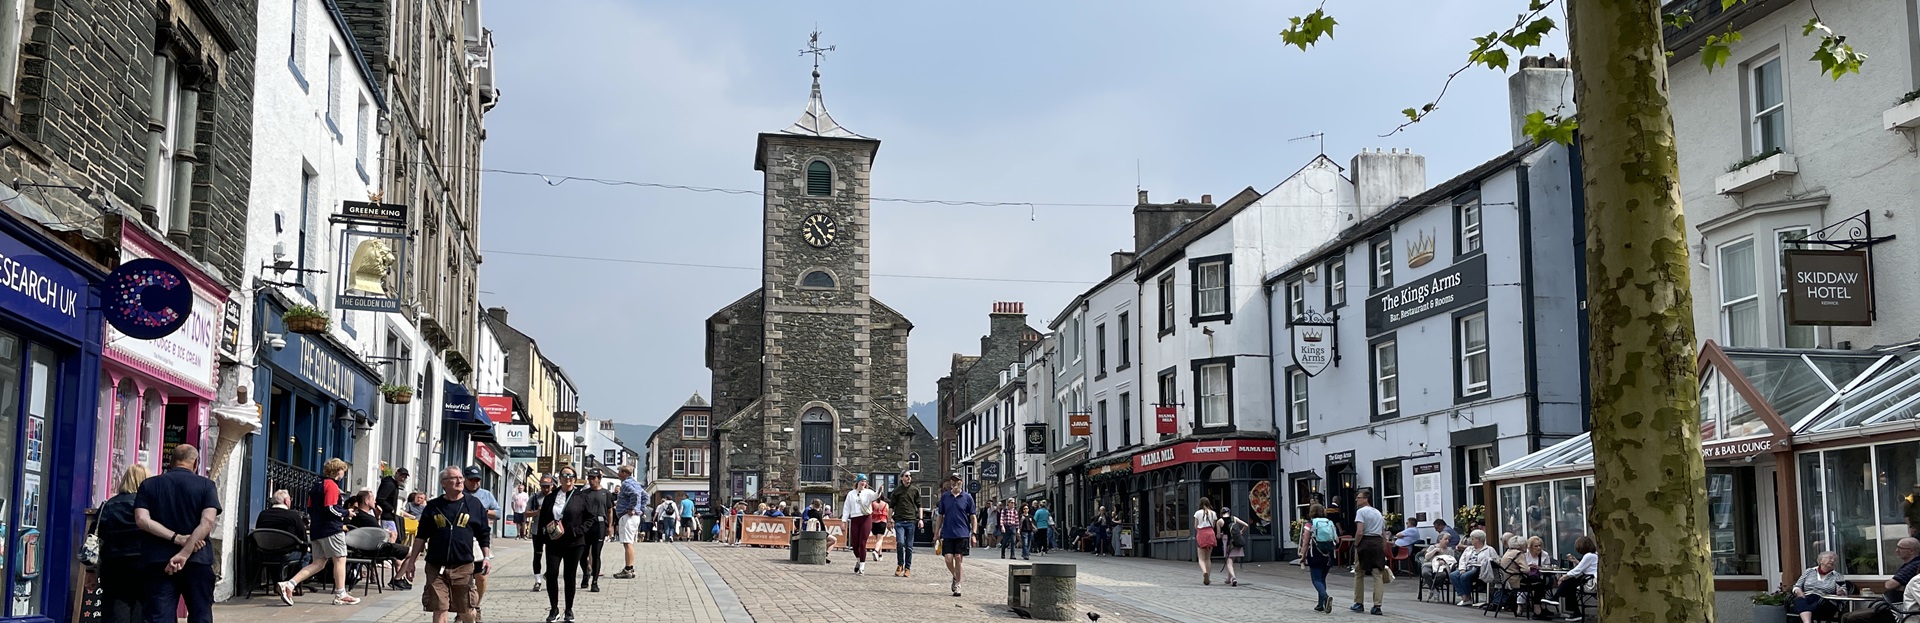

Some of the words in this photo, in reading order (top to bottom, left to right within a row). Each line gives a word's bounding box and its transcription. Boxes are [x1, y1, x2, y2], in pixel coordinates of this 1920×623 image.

[349, 206, 379, 215] GREENE
[380, 209, 400, 217] KING
[1797, 271, 1858, 284] SKIDDAW
[1382, 294, 1400, 312] The
[1401, 284, 1429, 305] Kings
[1431, 272, 1461, 295] Arms
[1808, 286, 1851, 299] HOTEL
[60, 286, 77, 318] UK
[341, 297, 353, 306] THE
[354, 298, 379, 308] GOLDEN
[381, 300, 396, 309] LION
[1401, 303, 1430, 319] Restaurant
[1430, 300, 1434, 309] &
[1435, 294, 1454, 307] Rooms
[1301, 346, 1325, 355] Kings
[300, 336, 314, 380] THE
[315, 348, 340, 397] GOLDEN
[341, 366, 354, 405] LION
[1192, 446, 1214, 454] MAMA
[1714, 447, 1720, 456] &
[1721, 444, 1737, 455] BAR
[1738, 440, 1771, 453] LOUNGE
[1141, 452, 1160, 467] MAMA
[1161, 448, 1175, 462] MIA
[746, 522, 786, 533] JAVA
